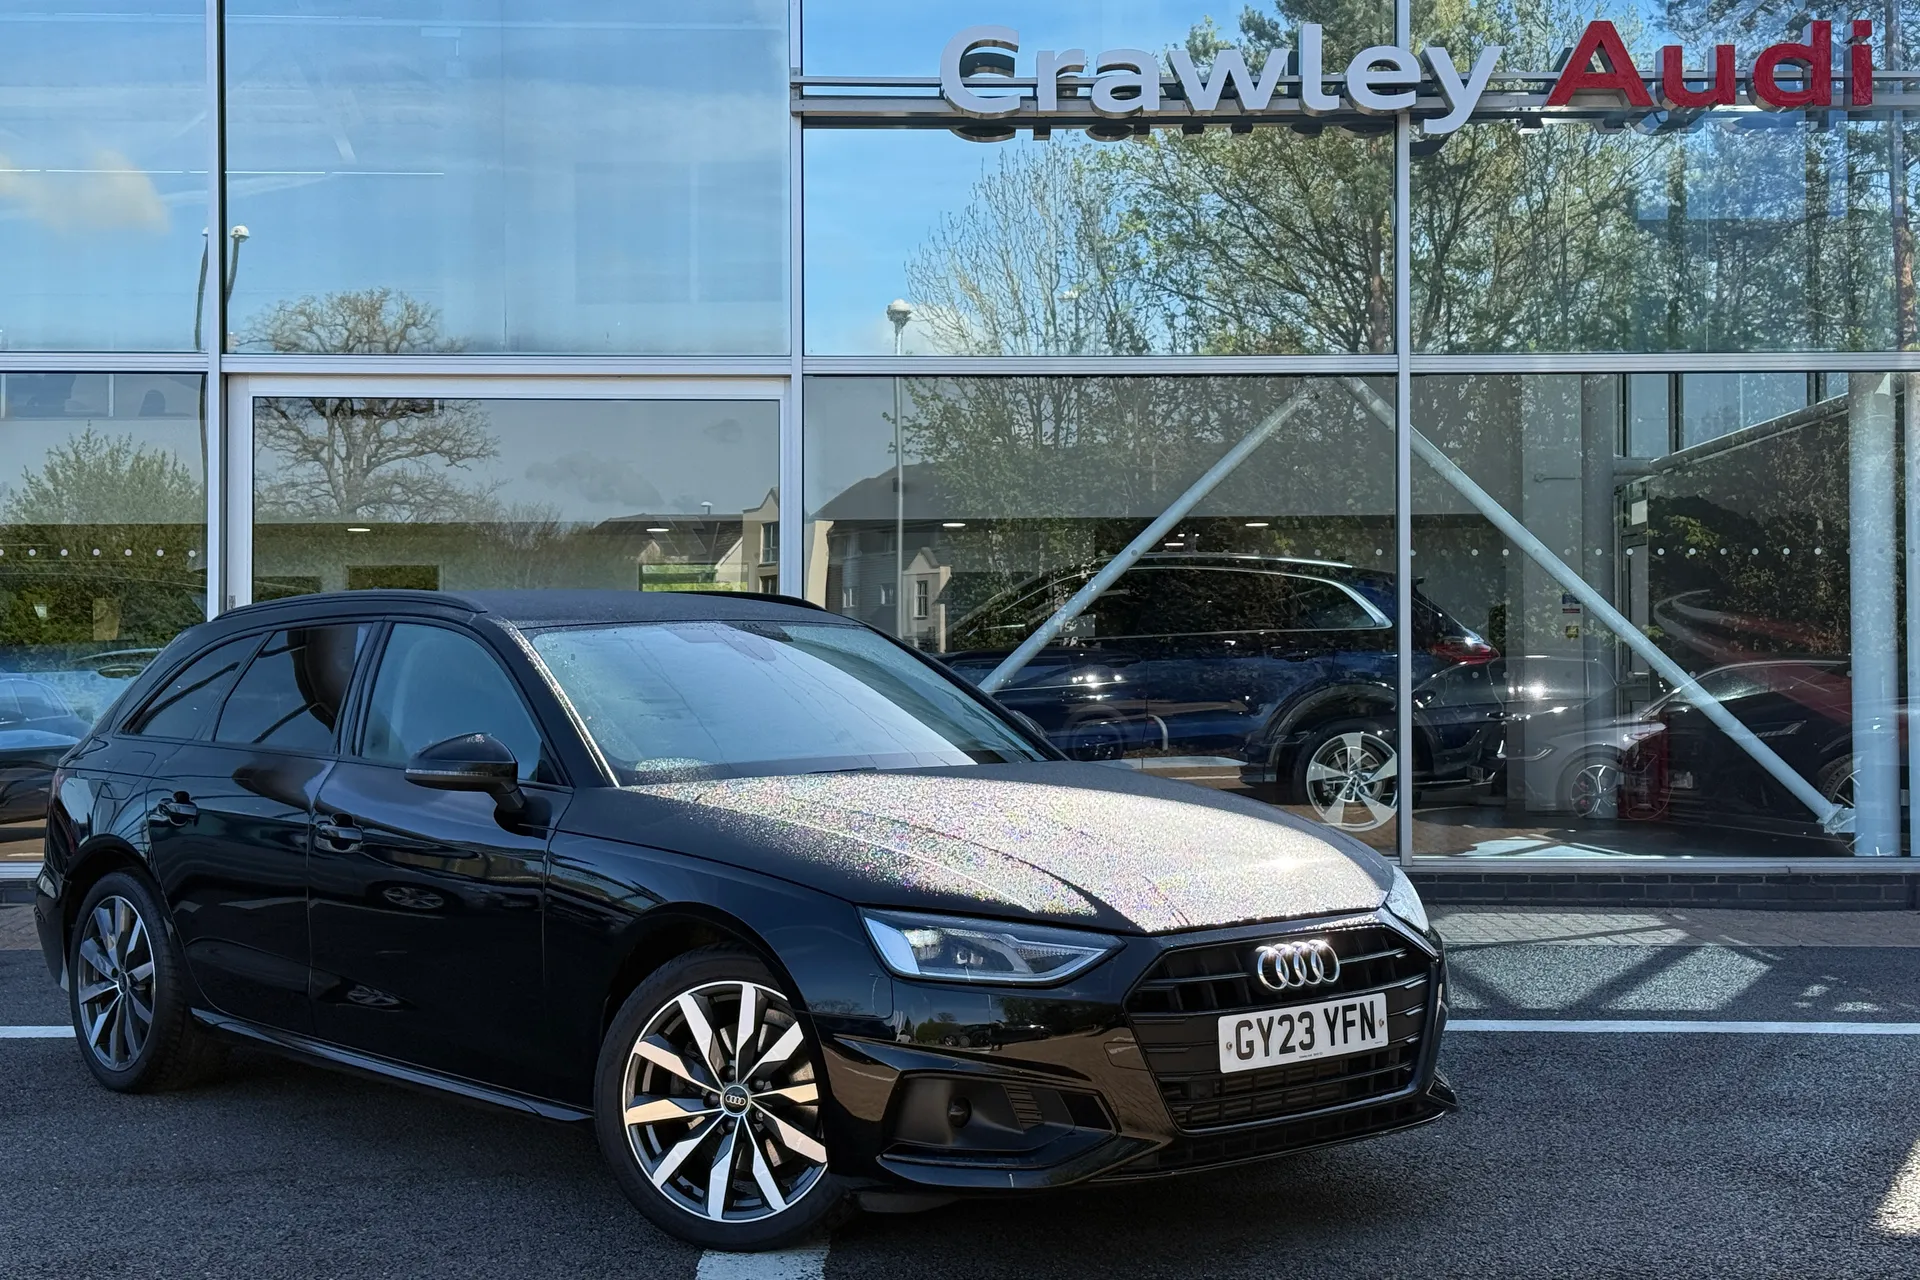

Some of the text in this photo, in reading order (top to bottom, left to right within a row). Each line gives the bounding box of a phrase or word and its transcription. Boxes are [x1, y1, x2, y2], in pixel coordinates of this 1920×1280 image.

[940, 19, 1873, 136] Crawley Audi
[1235, 1000, 1377, 1061] GY23 YFN
